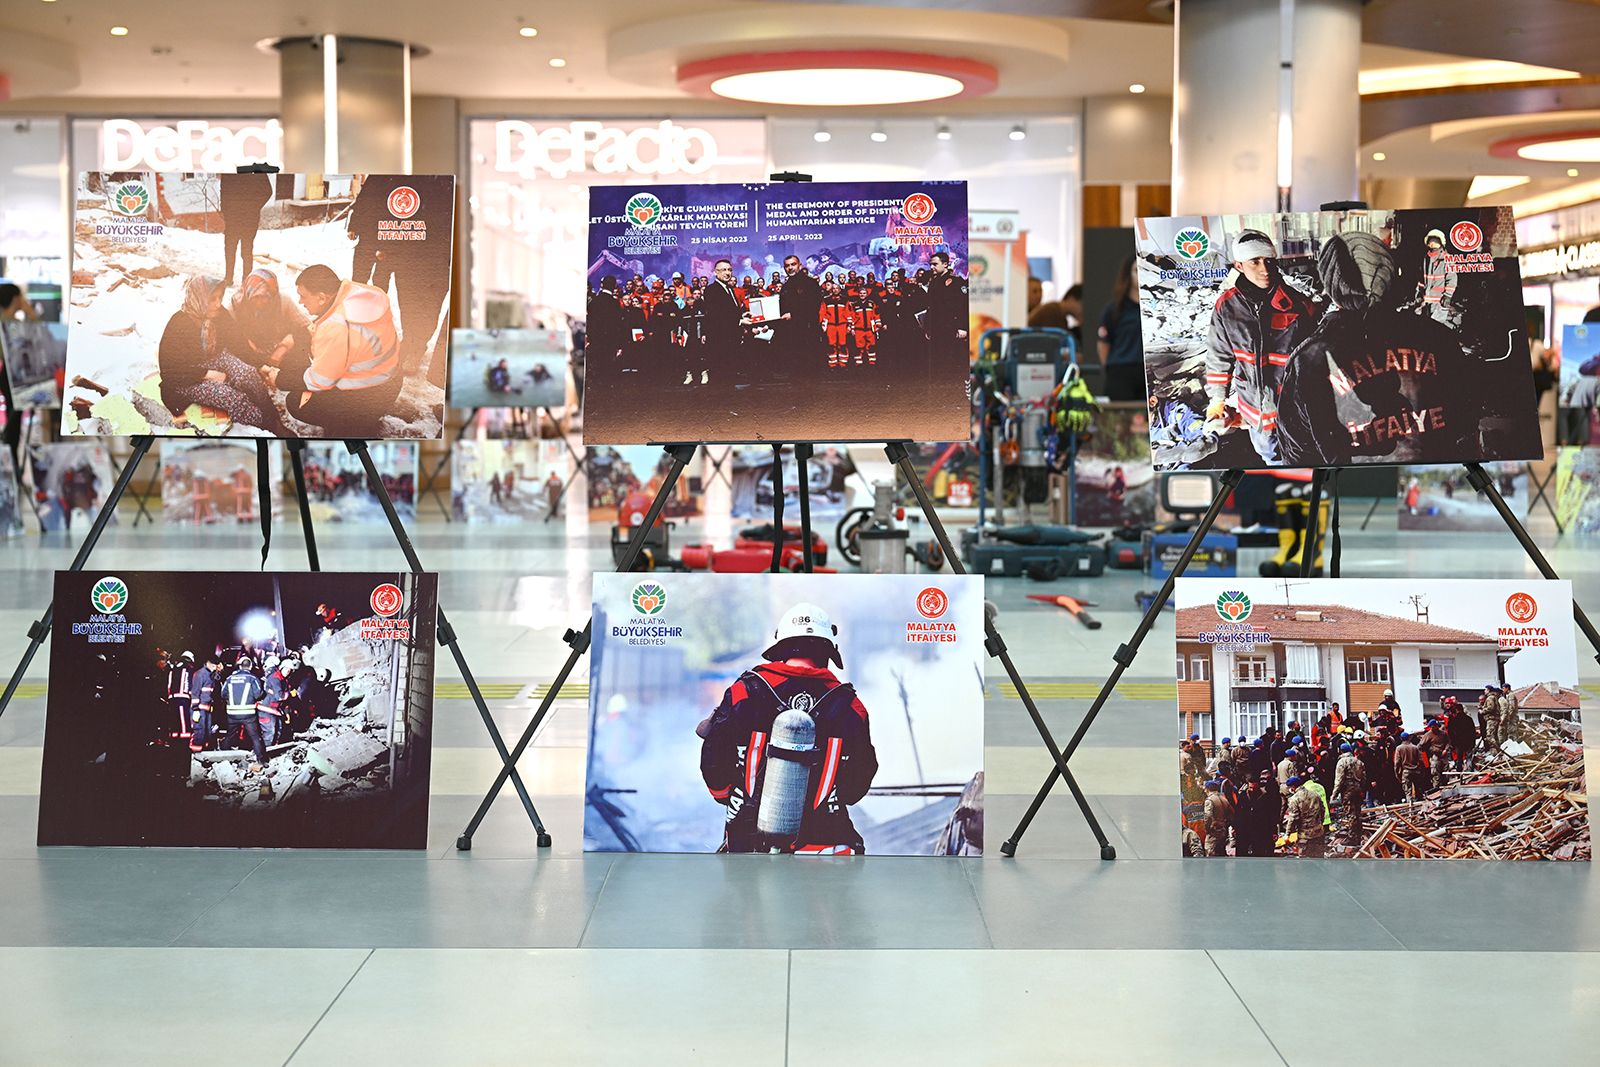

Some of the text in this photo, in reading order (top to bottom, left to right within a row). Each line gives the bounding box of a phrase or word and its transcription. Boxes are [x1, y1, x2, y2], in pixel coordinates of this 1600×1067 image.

[103, 119, 284, 172] DeFact
[495, 119, 718, 175] DeFacto
[852, 199, 904, 207] PRESIDENTI
[686, 203, 748, 213] CUMHURİYETİ
[822, 209, 852, 217] ORDER
[855, 208, 867, 216] OF
[696, 212, 748, 221] MADALYASI
[378, 221, 426, 230] MALATYA
[680, 221, 712, 230] TEVCİH
[715, 220, 748, 229] TÖRENİ
[766, 218, 836, 227] HUMANITARIAN
[96, 225, 163, 235] BÜYÜKŞEHİR
[895, 226, 943, 235] MALATYA
[378, 231, 426, 240] İTFAİYESİ
[608, 236, 677, 248] BÜYÜKŞEHİR
[895, 236, 943, 245] İTFAİYESİ
[1445, 253, 1493, 263] MALATYA
[1176, 261, 1212, 269] MALATYA
[1445, 263, 1494, 272] İTFAİYESİ
[1160, 268, 1228, 280] BÜYÜKŞEHİR
[1327, 348, 1437, 396] MALATYA
[1347, 406, 1446, 447] İTFAİYE
[90, 614, 127, 622] MALATYA
[792, 616, 811, 624] 086
[361, 619, 410, 628] MALATYA
[906, 622, 957, 631] MALATYA
[72, 623, 142, 635] BÜYÜKŞEHİR
[612, 626, 682, 638] BÜYÜKŞEHİR
[1498, 627, 1548, 636] MALATYA
[361, 629, 410, 639] İTFAİYESİ
[906, 633, 957, 642] İTFAİYESİ
[1199, 632, 1271, 644] BÜYÜKŞEHİR
[1499, 637, 1549, 647] İTFAİYESİ
